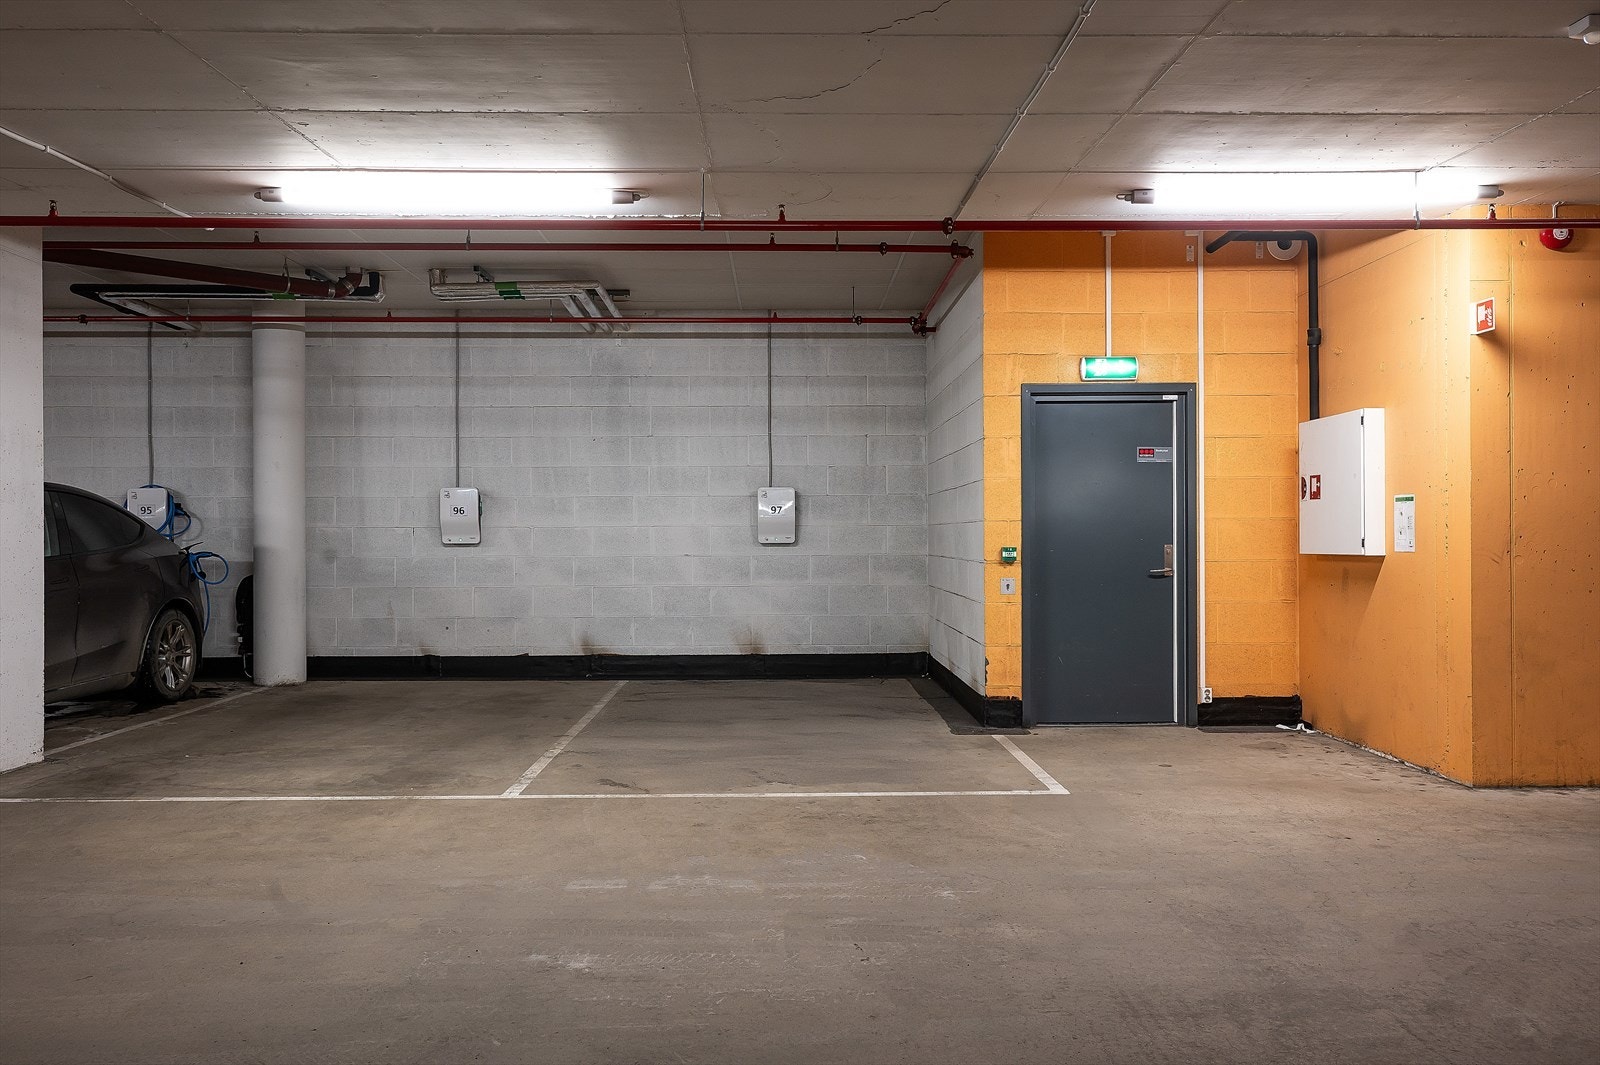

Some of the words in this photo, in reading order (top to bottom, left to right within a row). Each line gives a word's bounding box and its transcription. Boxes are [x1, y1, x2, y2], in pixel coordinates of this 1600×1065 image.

[140, 506, 152, 515] 95
[453, 506, 465, 515] 96
[770, 506, 782, 514] 97
